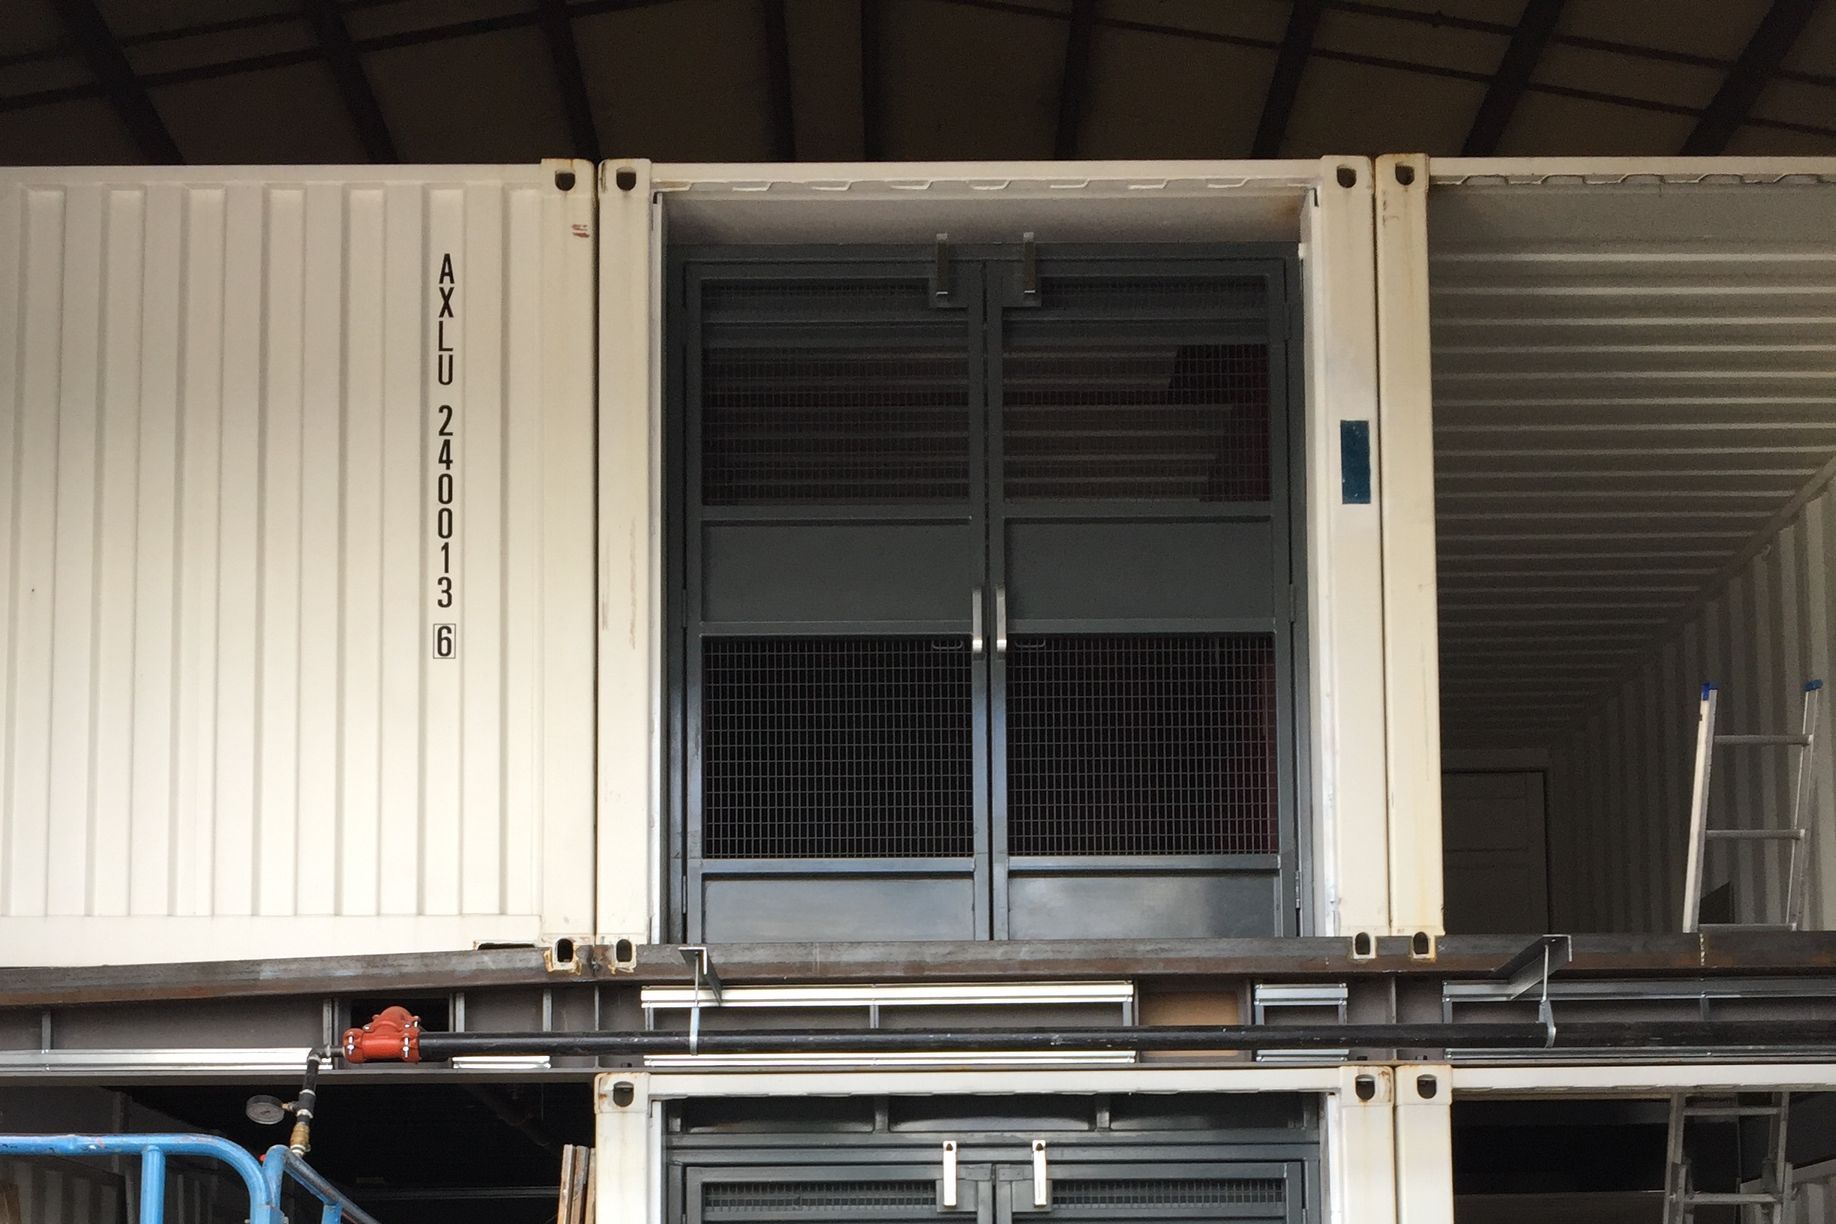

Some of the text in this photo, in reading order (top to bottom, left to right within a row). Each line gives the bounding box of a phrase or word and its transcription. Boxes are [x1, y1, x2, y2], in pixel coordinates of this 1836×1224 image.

[436, 253, 455, 657] AXLU 240013 6
